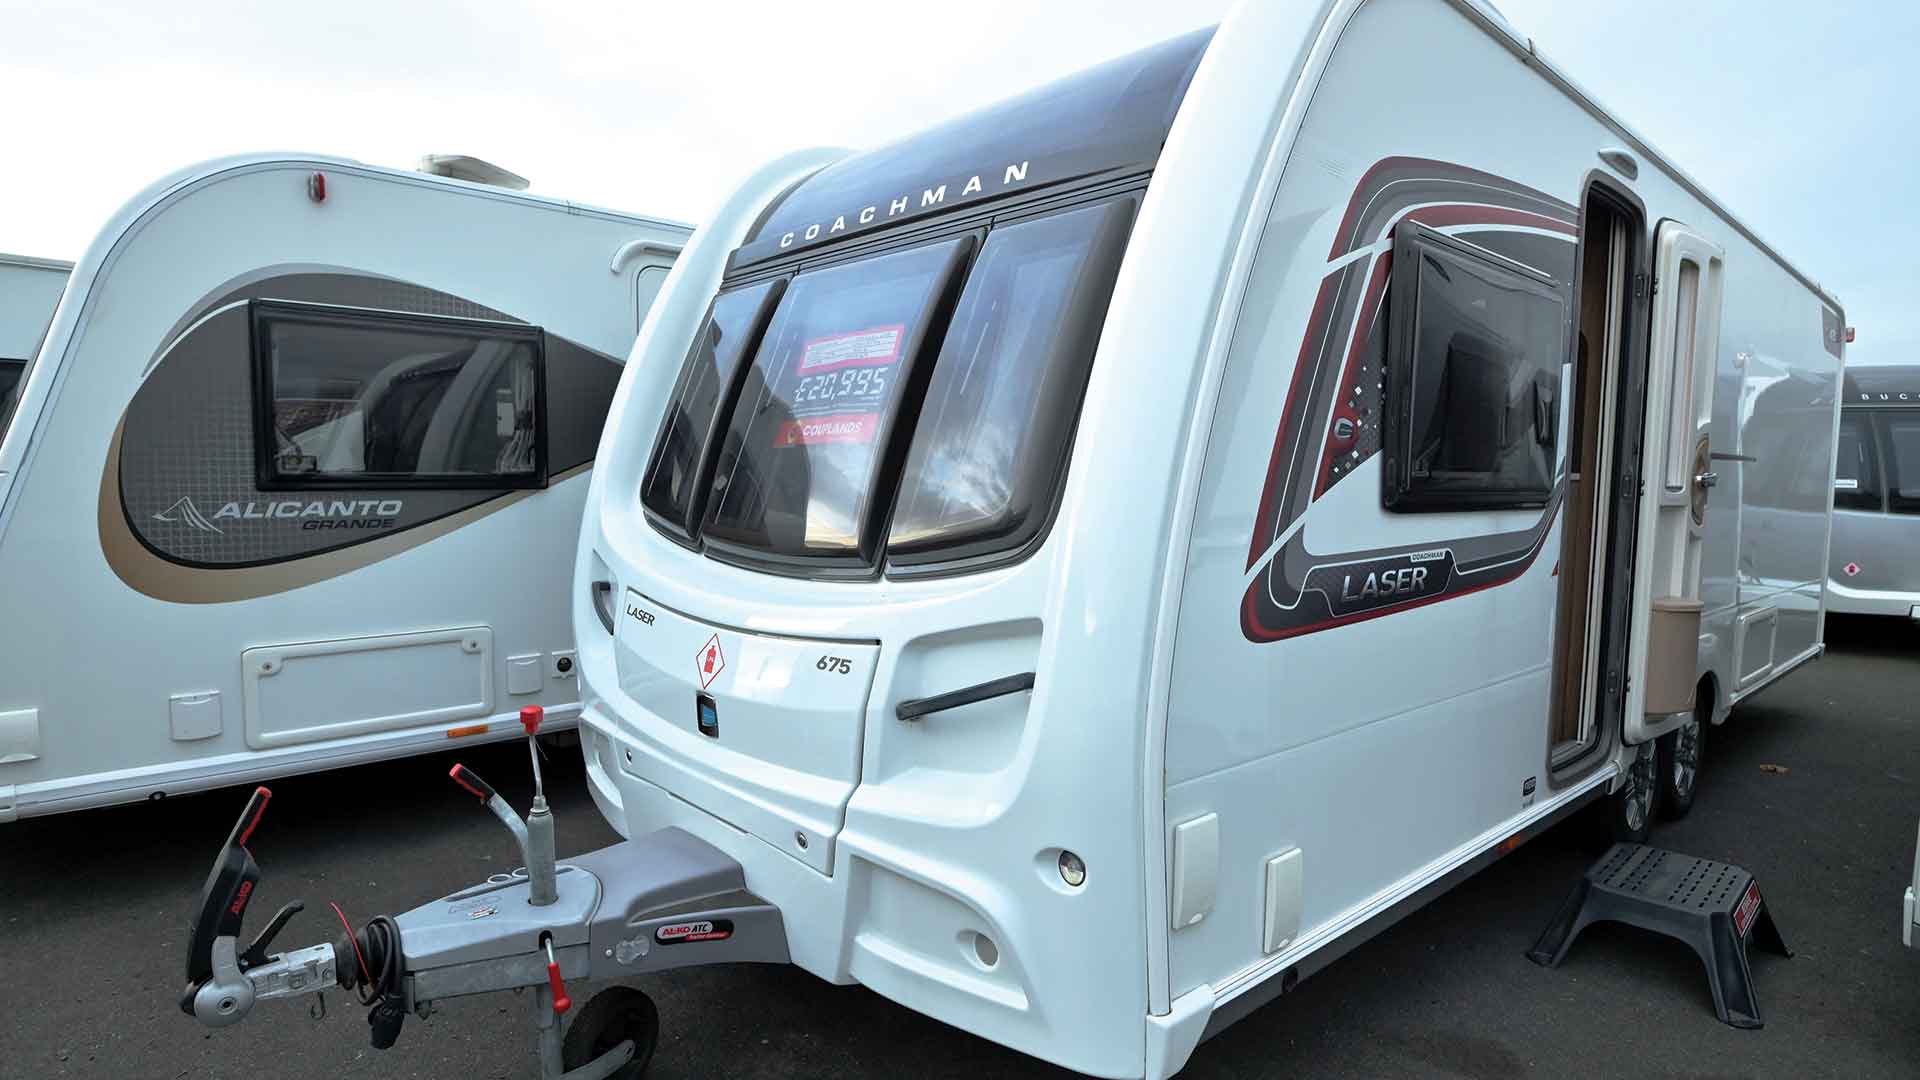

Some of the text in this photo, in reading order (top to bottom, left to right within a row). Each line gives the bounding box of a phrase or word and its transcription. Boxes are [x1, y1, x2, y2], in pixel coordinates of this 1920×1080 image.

[780, 160, 1030, 249] COACHMAN
[793, 367, 889, 402] £20,995
[1861, 392, 1920, 401] BUC
[213, 500, 402, 519] ALICANTO
[302, 518, 396, 530] GRANDE
[1412, 551, 1444, 561] COACHMAN
[1342, 566, 1428, 600] LASER
[626, 604, 655, 626] LASER
[816, 655, 852, 675] 675
[691, 923, 709, 933] ATC
